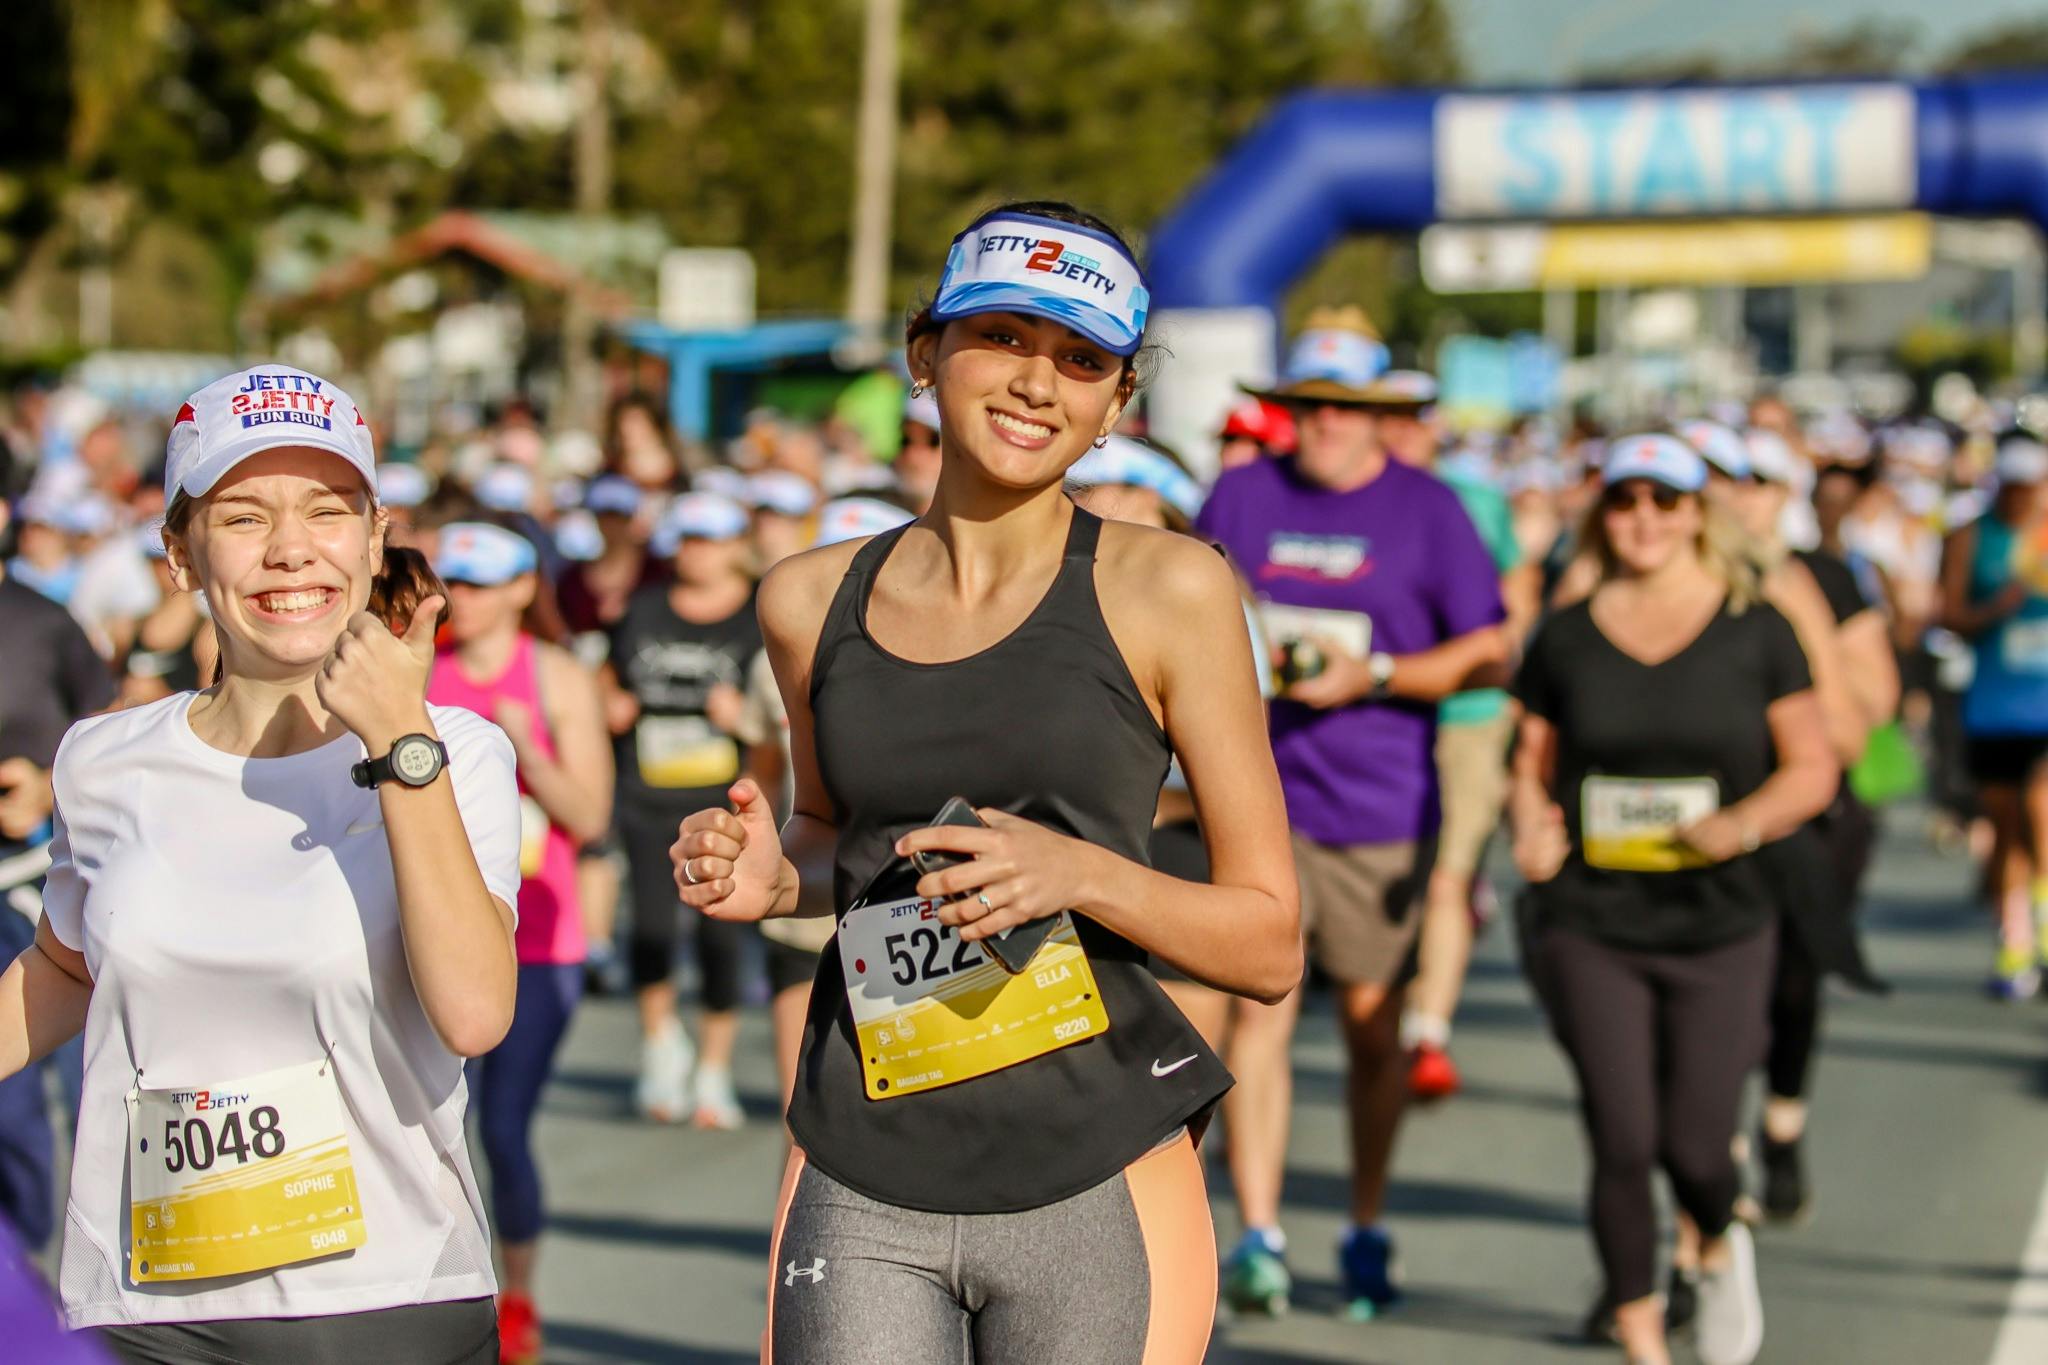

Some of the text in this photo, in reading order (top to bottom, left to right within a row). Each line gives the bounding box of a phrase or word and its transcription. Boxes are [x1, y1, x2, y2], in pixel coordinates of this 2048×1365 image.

[1500, 92, 1854, 212] START
[240, 375, 322, 393] JETTY
[250, 411, 325, 428] FUN RUN
[885, 927, 987, 987] 522
[1034, 965, 1073, 990] ELLA
[1053, 1016, 1091, 1041] 5220
[896, 1070, 944, 1088] BAGGAGE TAG
[164, 1105, 286, 1173] 5048
[283, 1173, 336, 1199] SOPHIE
[311, 1228, 347, 1250] 5048
[154, 1262, 195, 1274] BAGGAGE TAG
